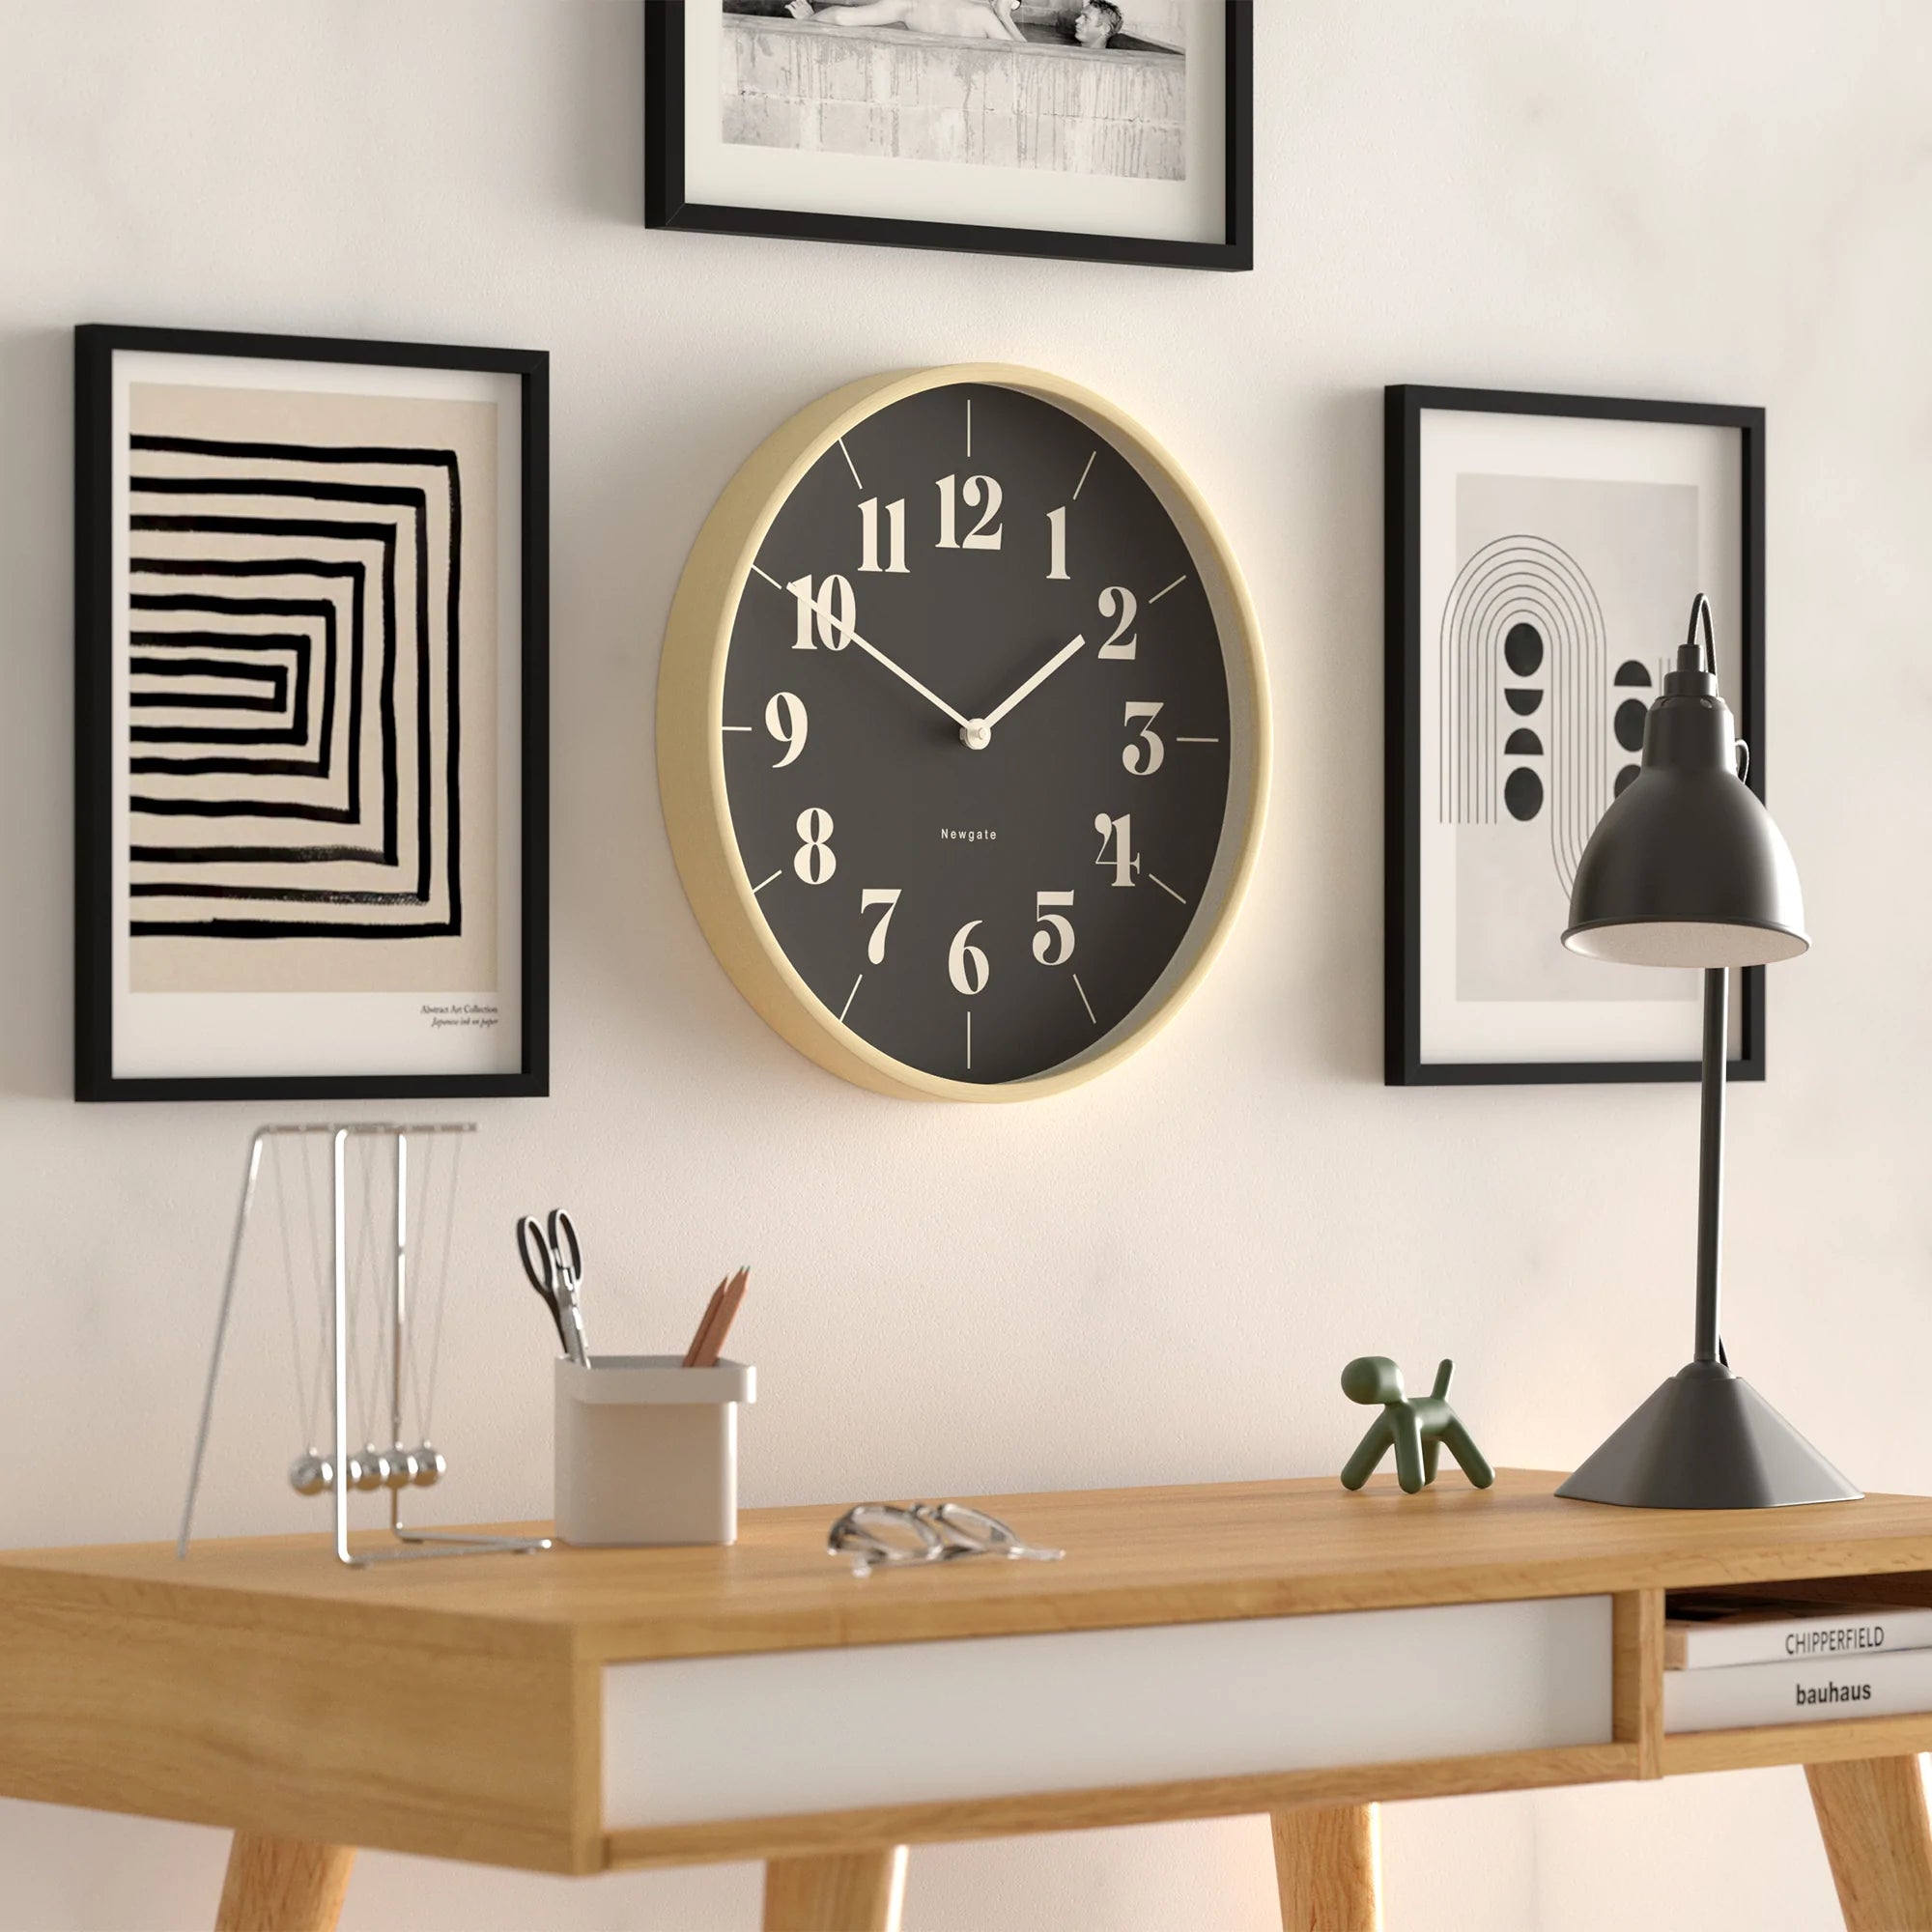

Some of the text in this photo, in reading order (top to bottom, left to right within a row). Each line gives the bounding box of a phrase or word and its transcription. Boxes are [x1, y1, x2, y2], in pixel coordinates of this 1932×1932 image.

[857, 497, 910, 574] 11
[935, 473, 1003, 551] 12
[1045, 505, 1071, 581] 1
[790, 573, 857, 652] 10
[1097, 585, 1137, 661] 2
[764, 691, 809, 769] 9
[1122, 701, 1165, 776] 3
[793, 807, 837, 886] 8
[940, 827, 998, 842] Newgate
[1094, 812, 1141, 887] 4
[860, 888, 902, 965] 7
[948, 920, 990, 996] 6
[1032, 889, 1075, 966] 5
[420, 1005, 498, 1014] Abstract Art Collection
[431, 1016, 459, 1029] Japanese
[460, 1017, 470, 1026] ink
[479, 1018, 498, 1029] paper
[1785, 1626, 1885, 1655] CHIPPERFIELD
[1796, 1681, 1872, 1706] bauhaus
